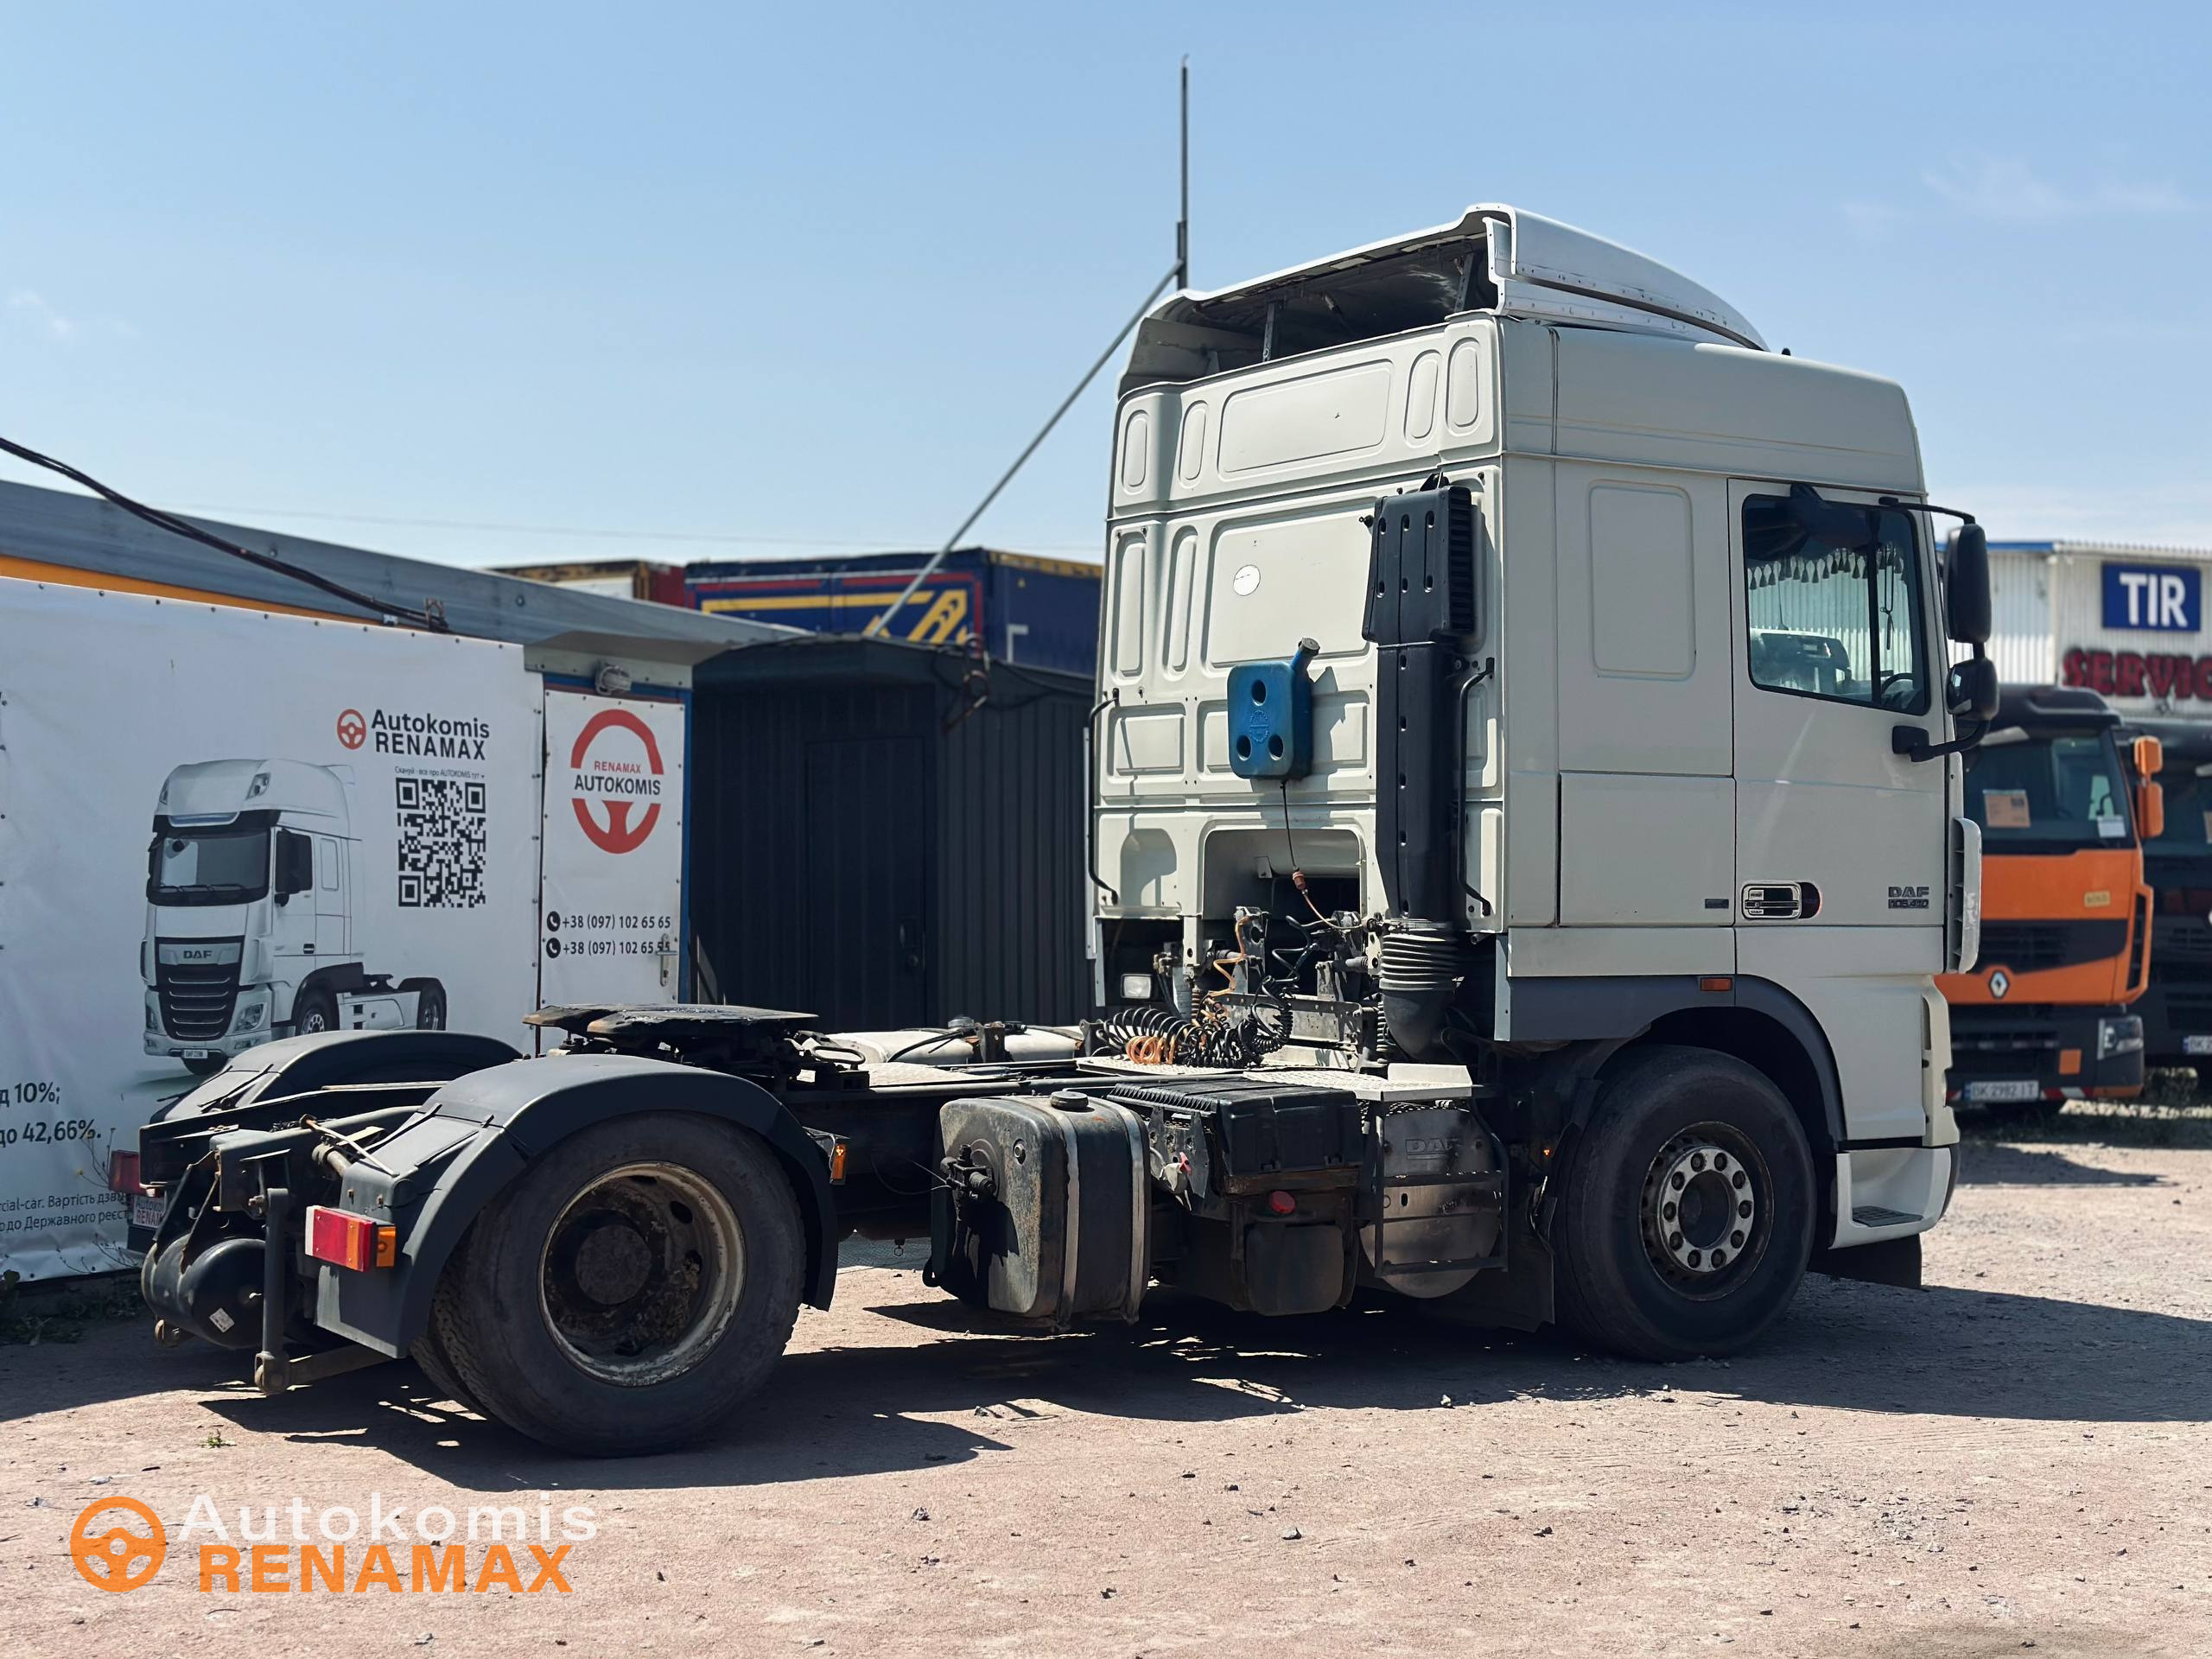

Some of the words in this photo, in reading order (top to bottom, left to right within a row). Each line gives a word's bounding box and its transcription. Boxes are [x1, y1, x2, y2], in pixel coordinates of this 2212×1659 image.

[2119, 572, 2189, 627] TIR
[371, 709, 490, 739] Autokomis
[375, 731, 486, 760] RENAMAX
[594, 760, 641, 774] RENAMAX
[574, 774, 661, 796] AUTOKOMIS
[1888, 887, 1929, 898] DAF
[562, 915, 584, 929] +38
[588, 914, 615, 930] (097)
[619, 916, 639, 929] 102
[641, 916, 655, 929] 65
[658, 916, 671, 929] 65
[183, 950, 213, 959] DAF
[563, 941, 585, 955] +38
[588, 940, 616, 957] (097)
[619, 942, 638, 955] 102
[640, 941, 654, 954] 65
[15, 1082, 60, 1104] 10%;
[22, 1119, 102, 1144] 42,66%.
[0, 1198, 45, 1211] cial-car.
[48, 1194, 95, 1209] Вартість
[24, 1212, 96, 1230] Державного
